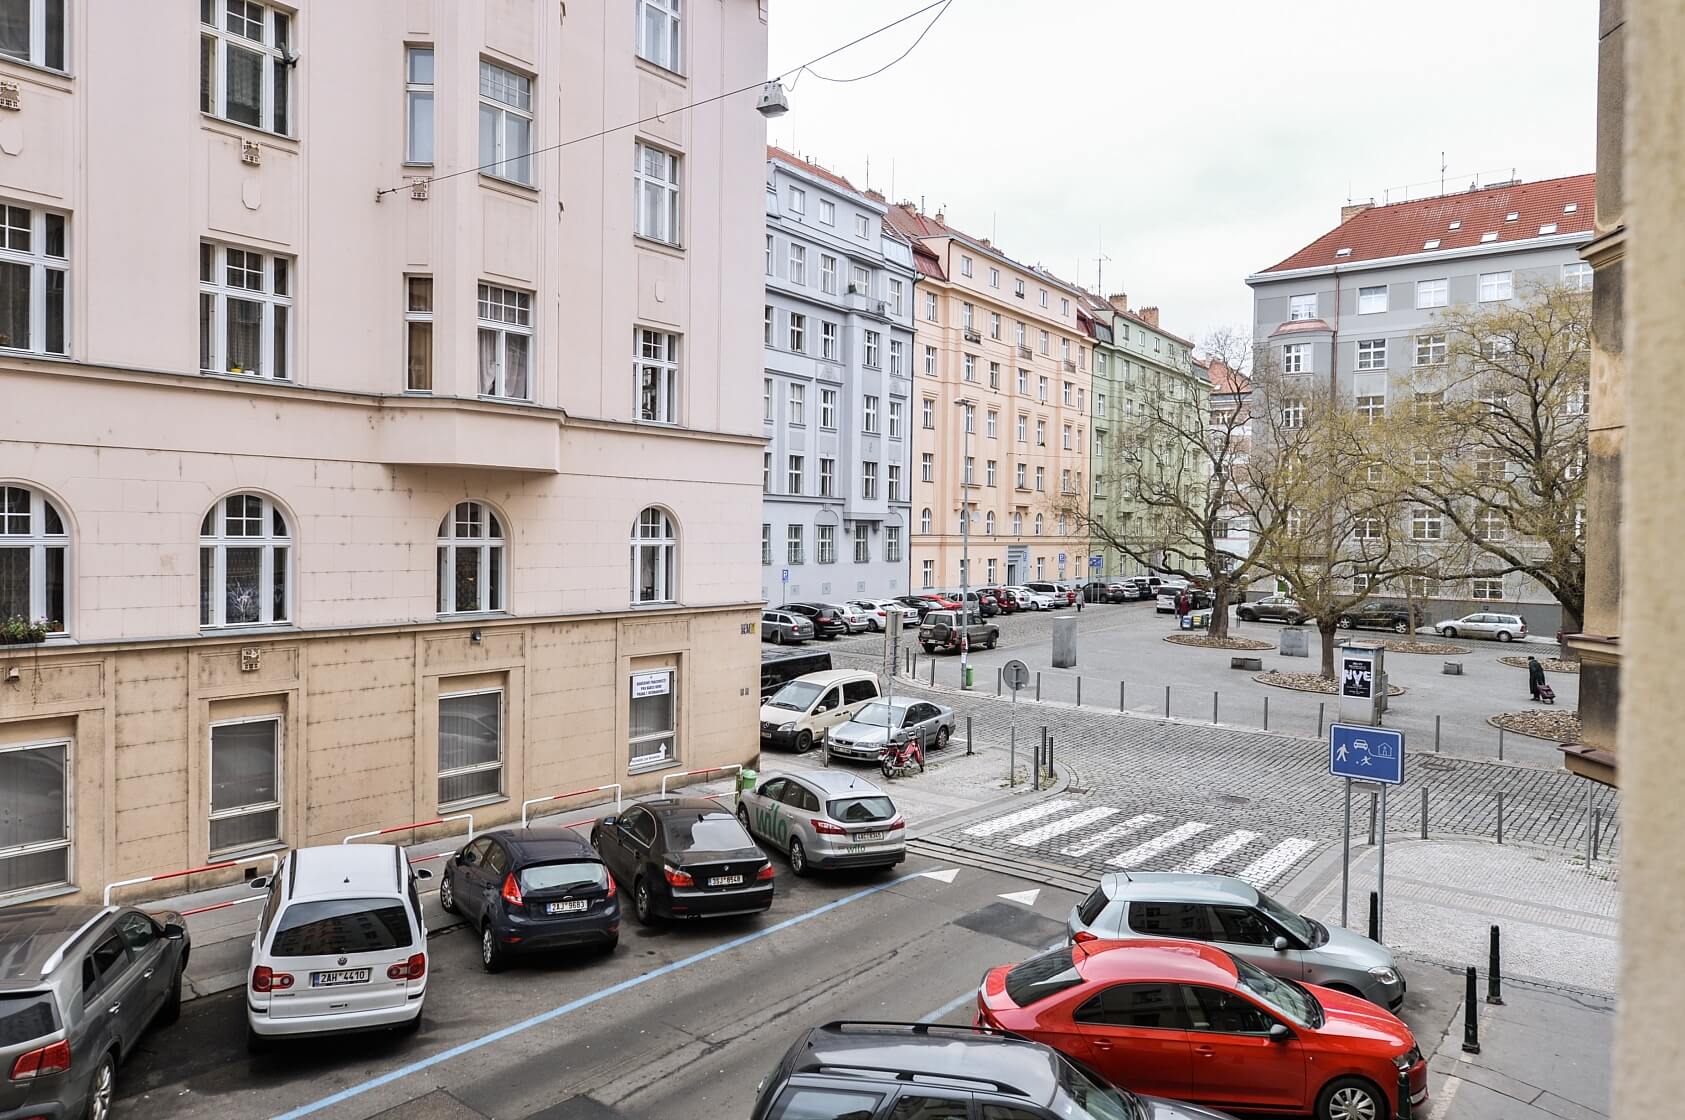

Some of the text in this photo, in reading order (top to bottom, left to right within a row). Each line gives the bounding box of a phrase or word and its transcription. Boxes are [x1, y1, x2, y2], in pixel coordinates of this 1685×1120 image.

[756, 803, 787, 847] wilo
[847, 843, 865, 853] wilo
[320, 971, 365, 983] 2AH 4410
